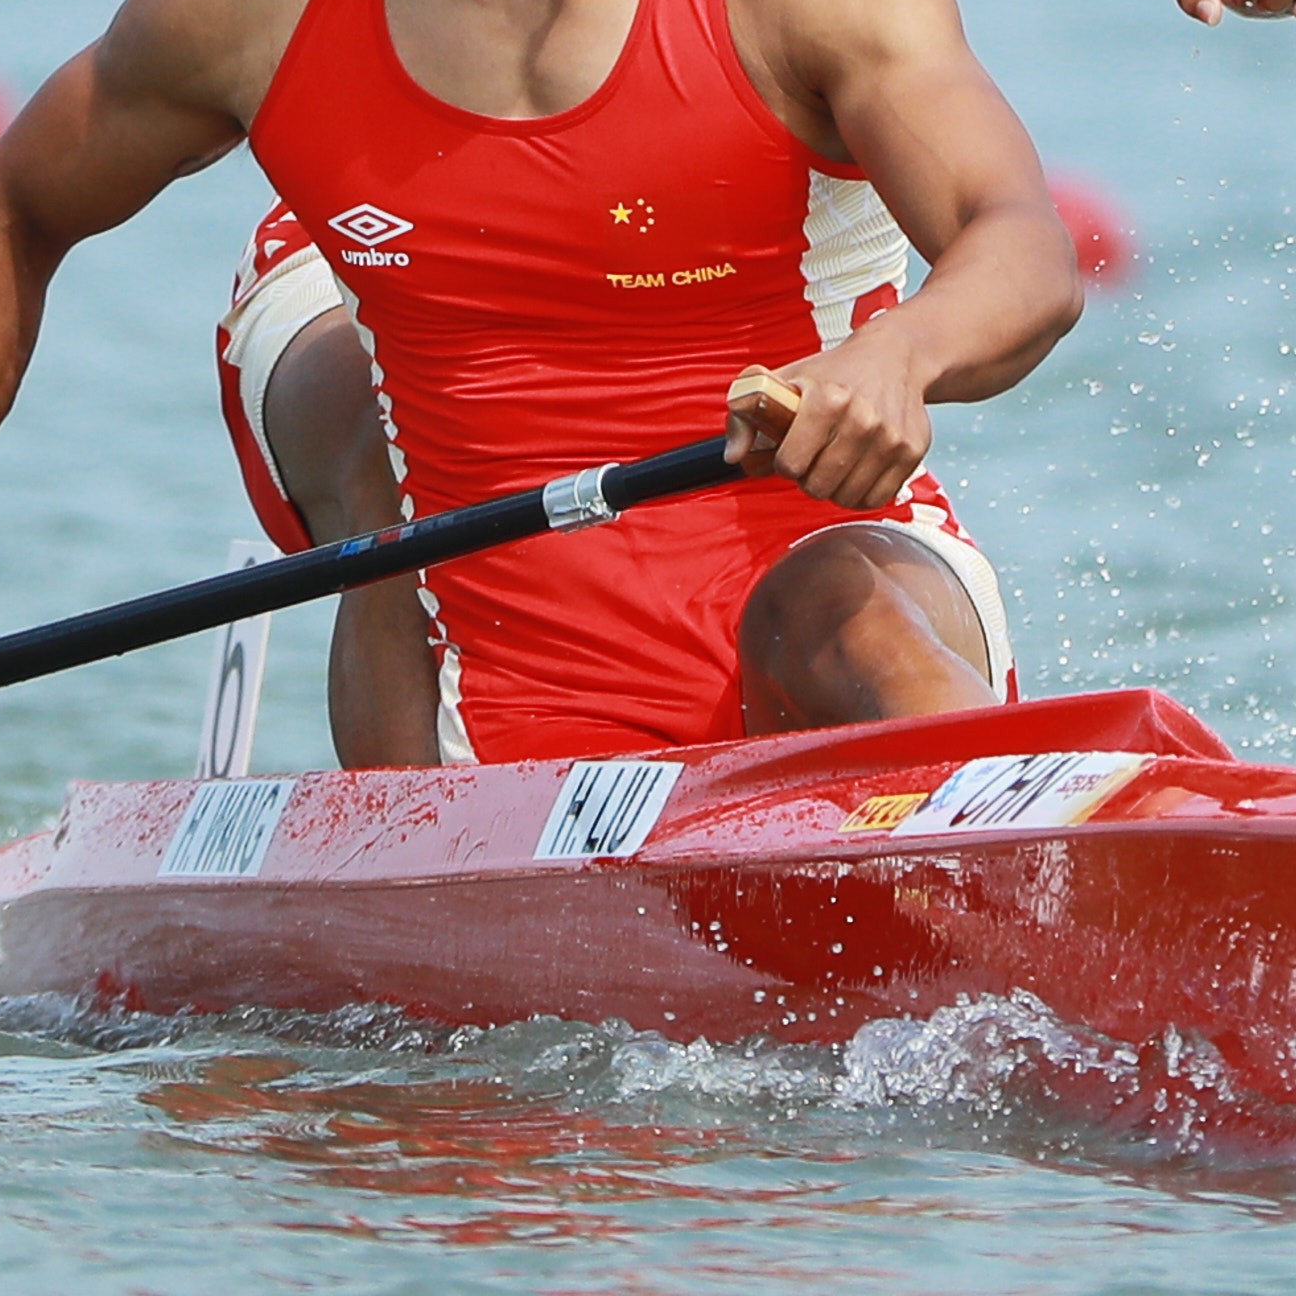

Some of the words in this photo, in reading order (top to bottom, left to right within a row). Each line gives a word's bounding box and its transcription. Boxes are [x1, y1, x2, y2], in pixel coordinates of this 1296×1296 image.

[341, 248, 409, 267] umbro
[607, 272, 665, 288] TEAM
[672, 262, 736, 286] CHINA
[582, 767, 663, 854] LIU
[949, 753, 1088, 827] CHN
